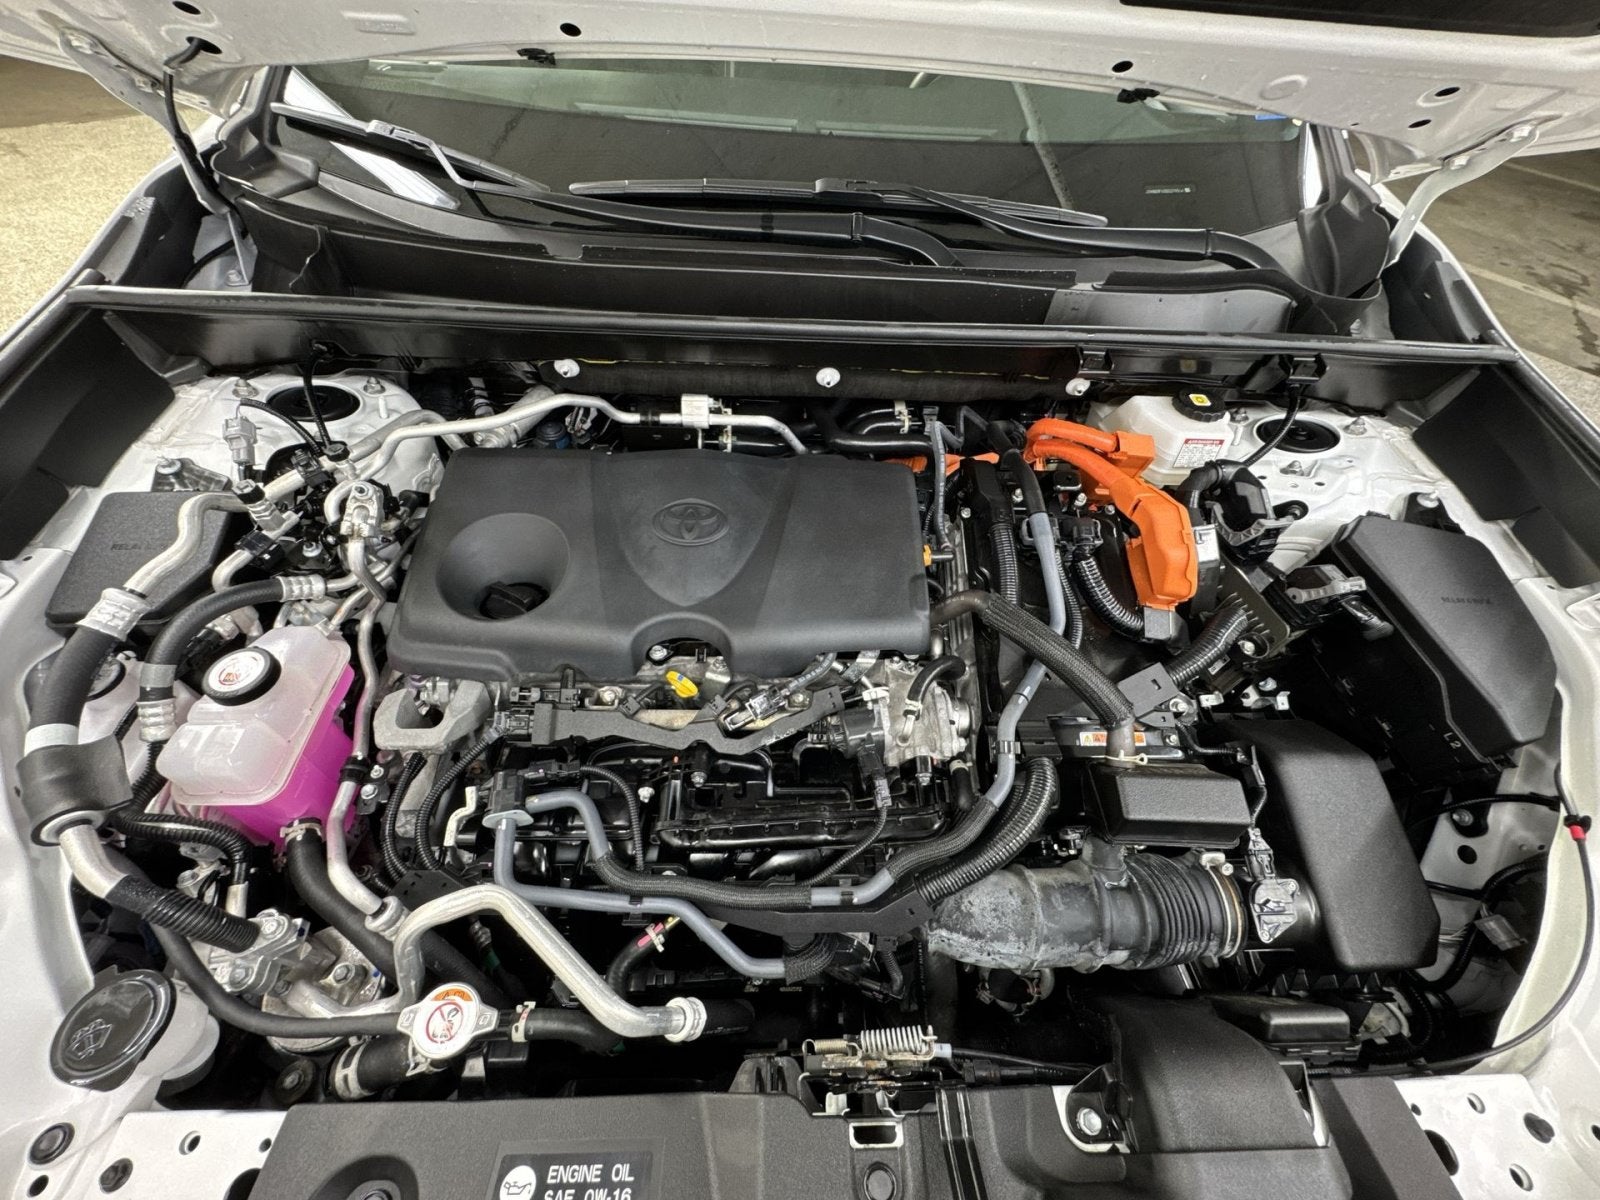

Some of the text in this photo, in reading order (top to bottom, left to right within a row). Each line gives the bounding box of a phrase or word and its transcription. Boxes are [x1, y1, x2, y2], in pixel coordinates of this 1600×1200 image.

[546, 1163, 635, 1184] ENGINE OIL
[544, 1189, 575, 1200] SAE
